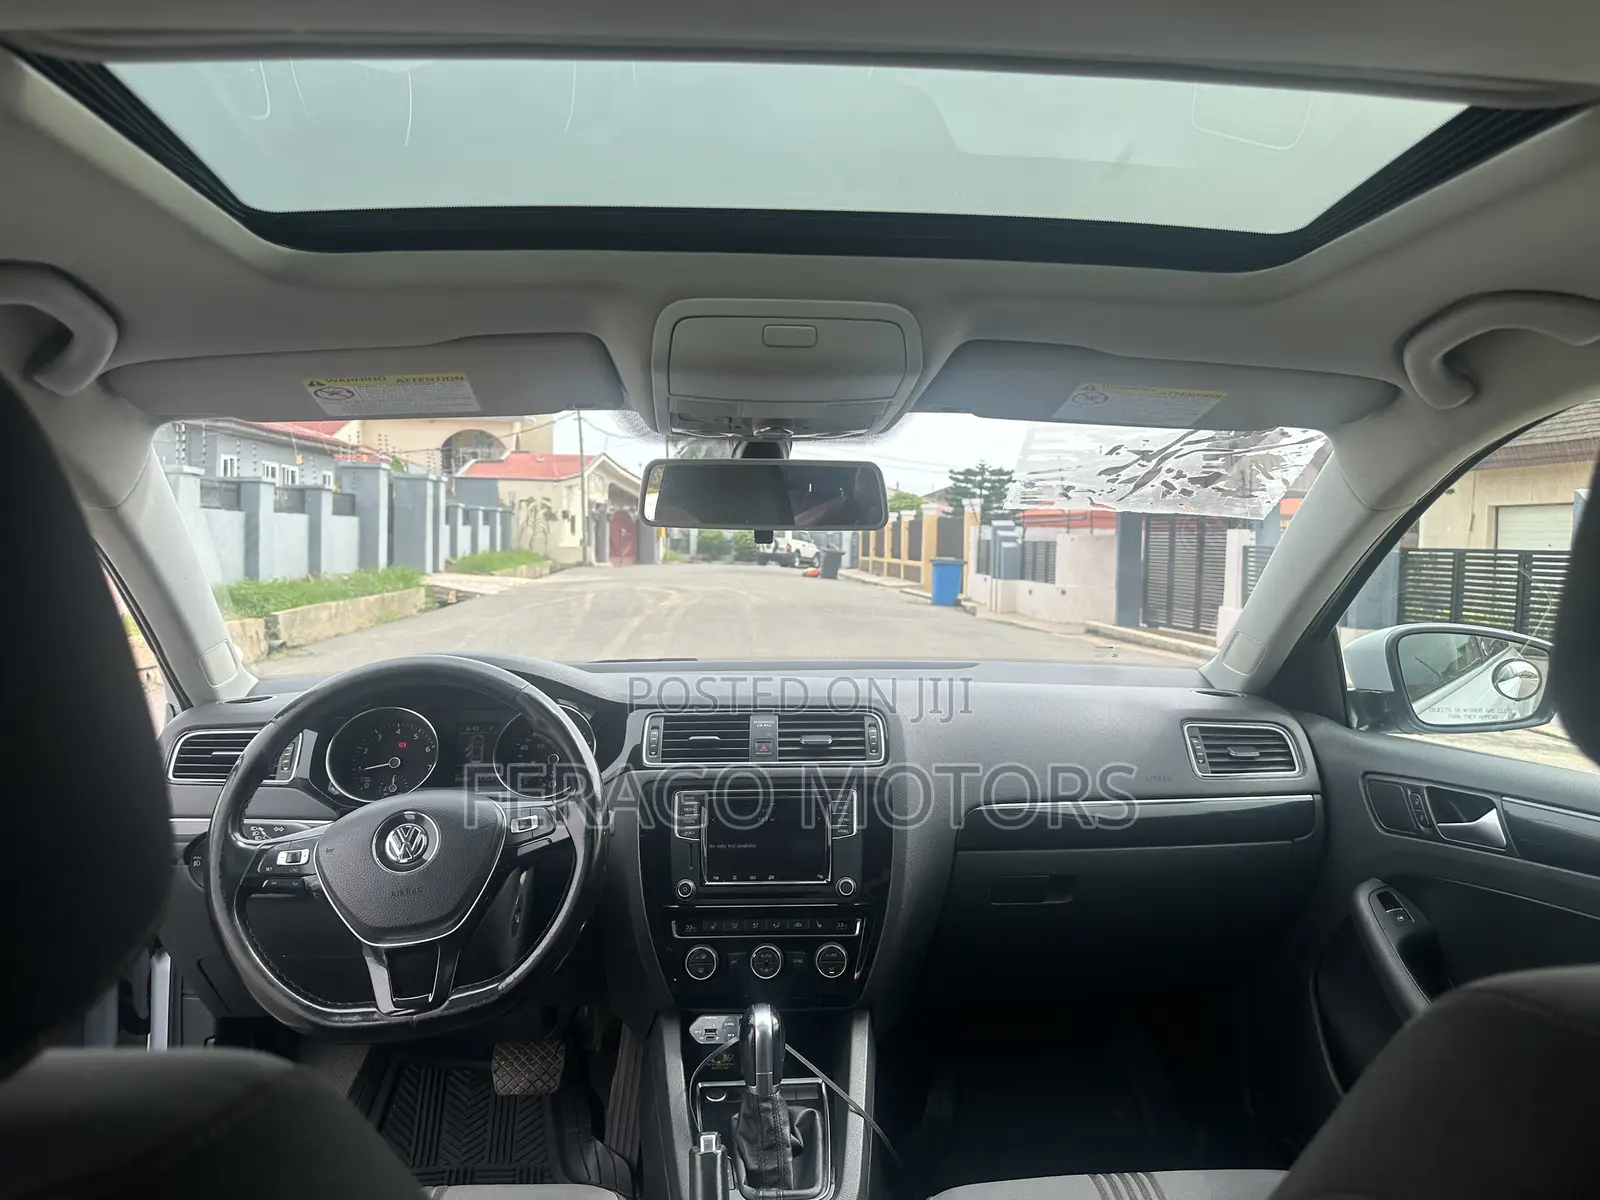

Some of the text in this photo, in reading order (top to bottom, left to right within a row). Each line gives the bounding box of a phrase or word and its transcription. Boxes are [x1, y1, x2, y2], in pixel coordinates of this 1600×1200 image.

[396, 375, 464, 383] ATTENTION
[1160, 390, 1222, 399] ATTENTION
[386, 823, 429, 866] VW
